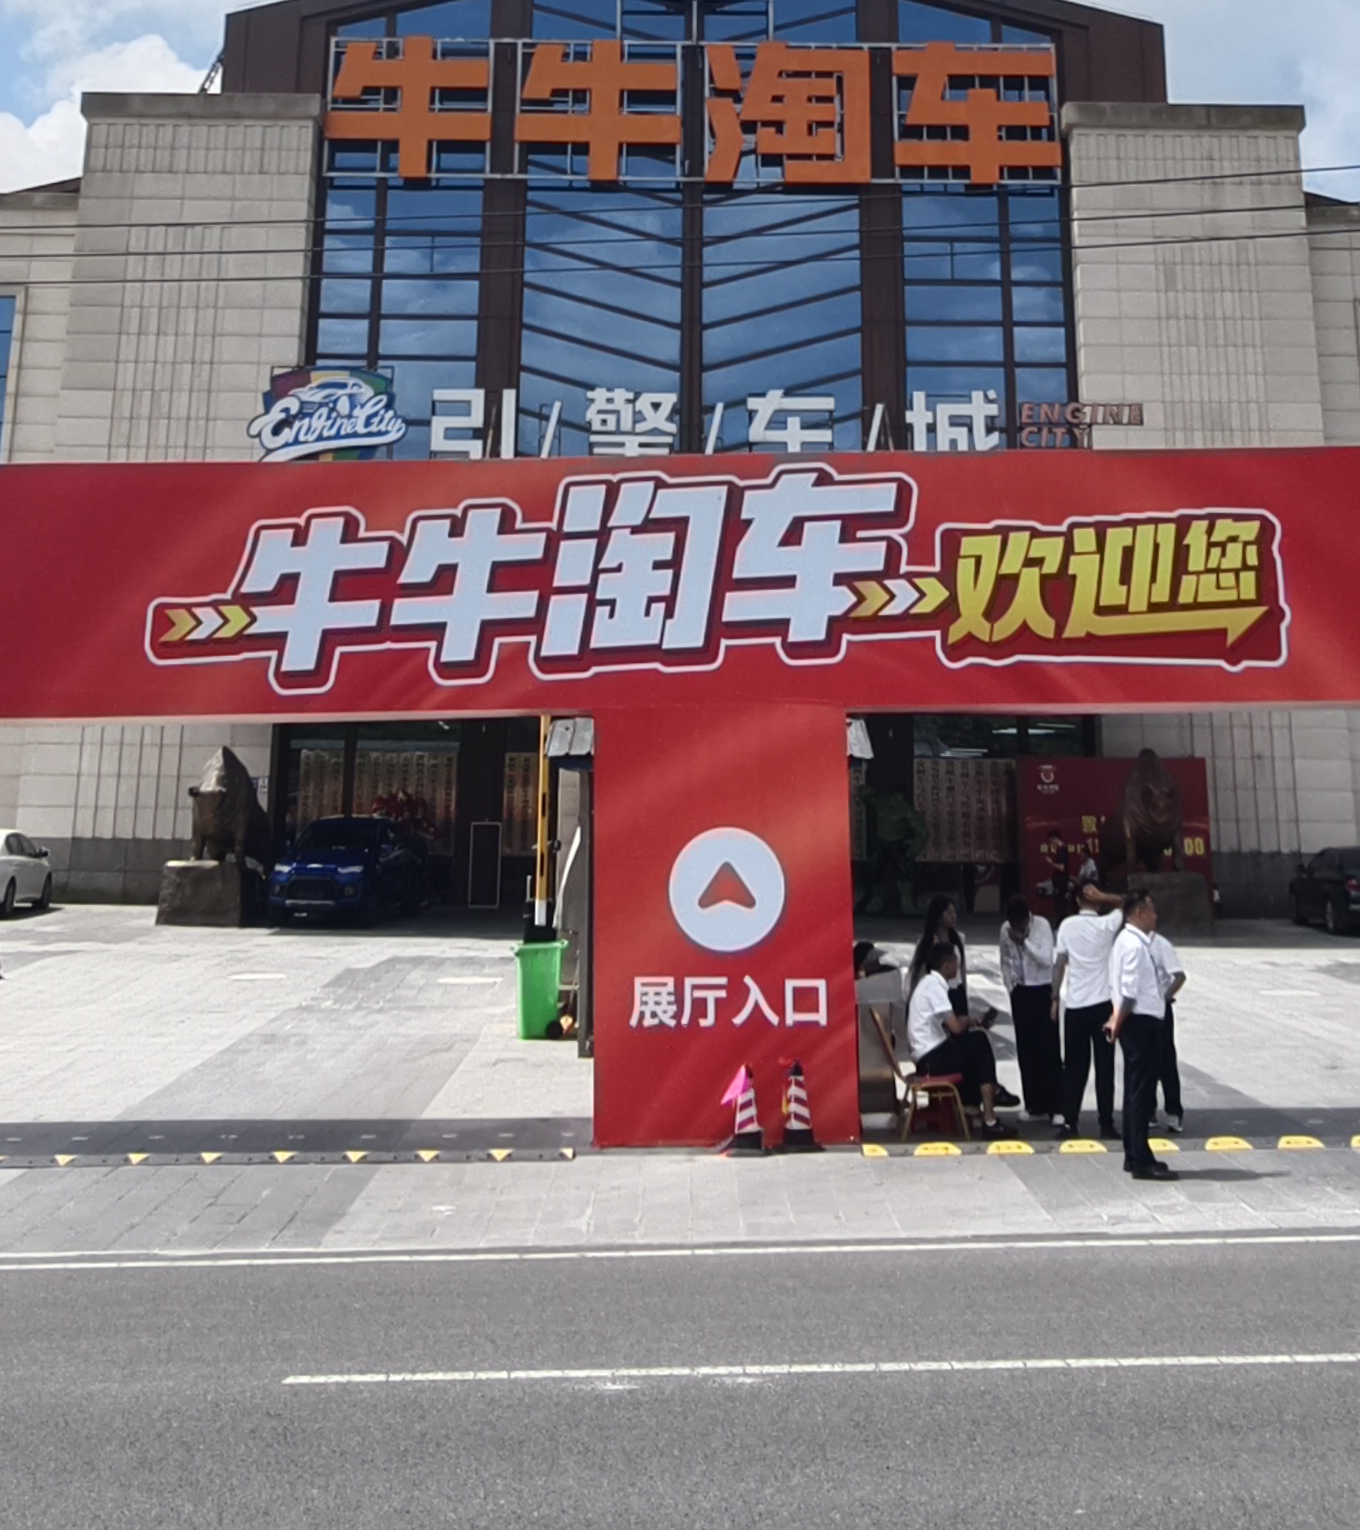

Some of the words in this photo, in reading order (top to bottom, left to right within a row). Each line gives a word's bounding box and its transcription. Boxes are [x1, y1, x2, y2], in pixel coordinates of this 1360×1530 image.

[324, 36, 1062, 184] 牛牛淘车
[1021, 402, 1143, 425] ENGINE
[1021, 426, 1090, 449] CITY
[242, 473, 898, 673] 牛牛淘车
[952, 519, 1269, 647] 欢迎您
[629, 975, 830, 1028] 展厅入口
